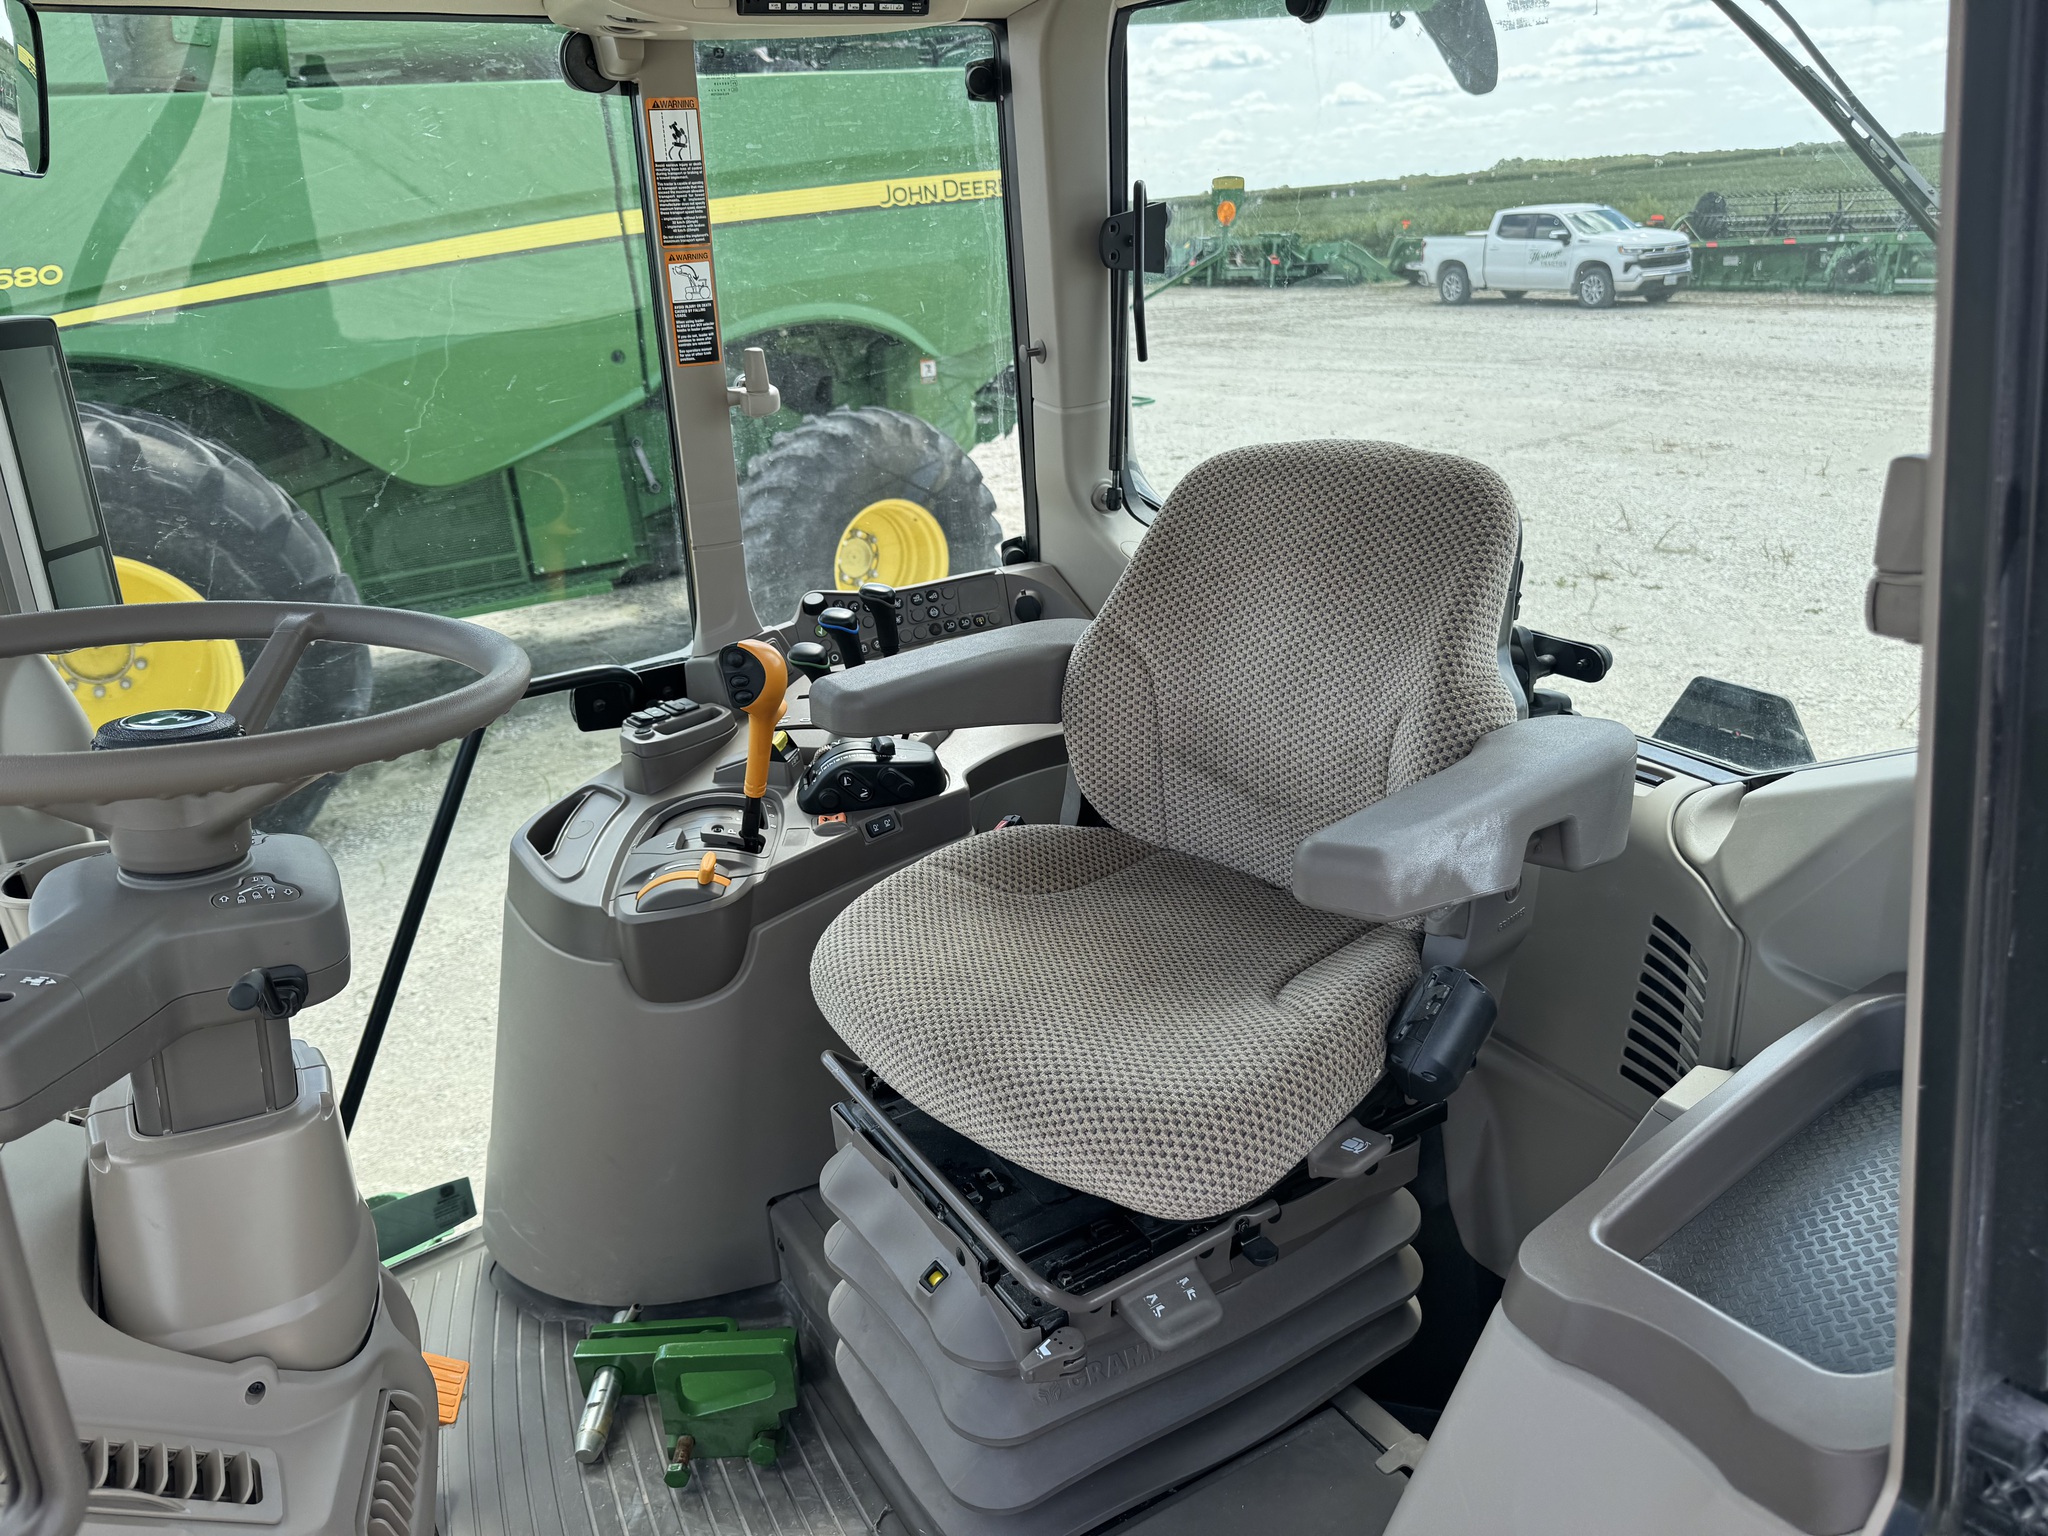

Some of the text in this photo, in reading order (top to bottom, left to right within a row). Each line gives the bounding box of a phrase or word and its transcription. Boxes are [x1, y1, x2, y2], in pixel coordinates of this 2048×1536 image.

[660, 100, 694, 108] WARNING
[880, 179, 1002, 204] JOHN DEER
